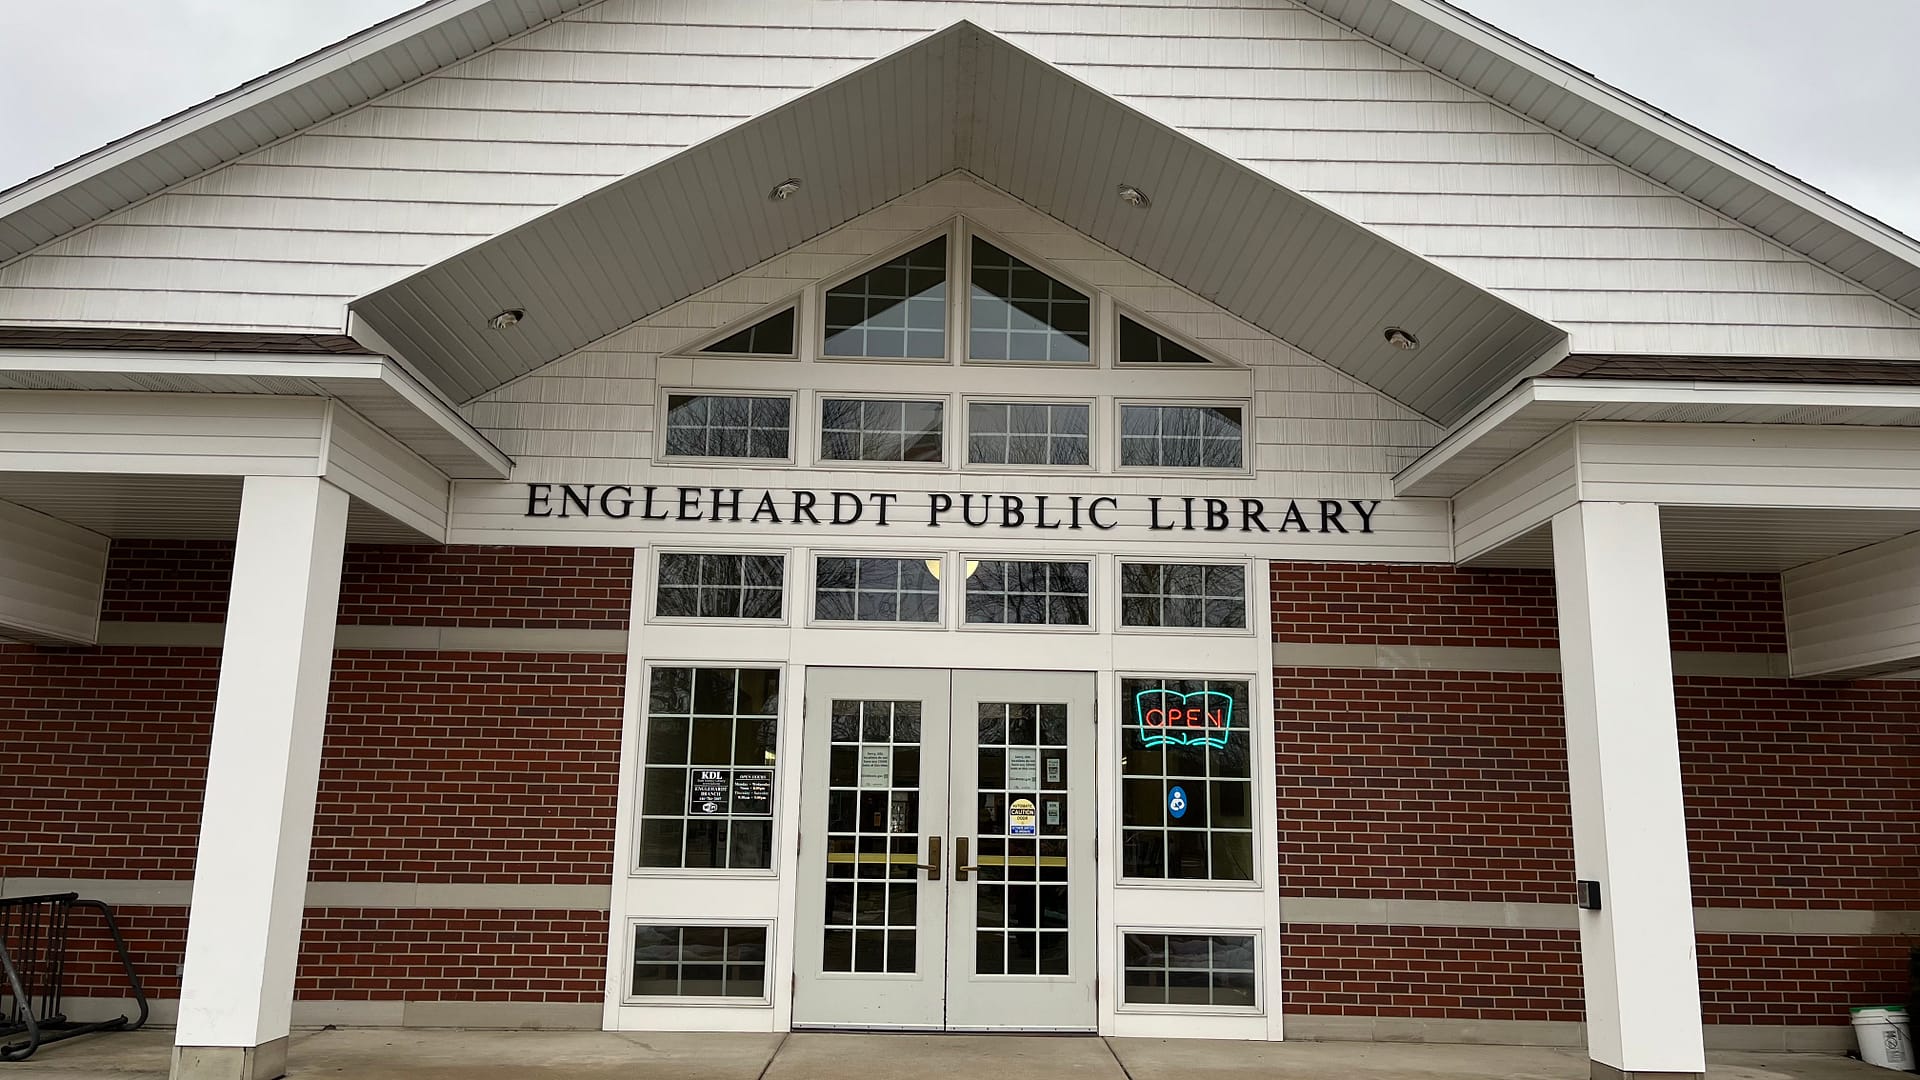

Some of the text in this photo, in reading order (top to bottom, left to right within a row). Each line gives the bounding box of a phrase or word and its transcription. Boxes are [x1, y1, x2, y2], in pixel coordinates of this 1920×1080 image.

[524, 483, 1381, 534] ENGLEHARDT PUBLIC LIBRARY
[1145, 708, 1222, 728] OPEN
